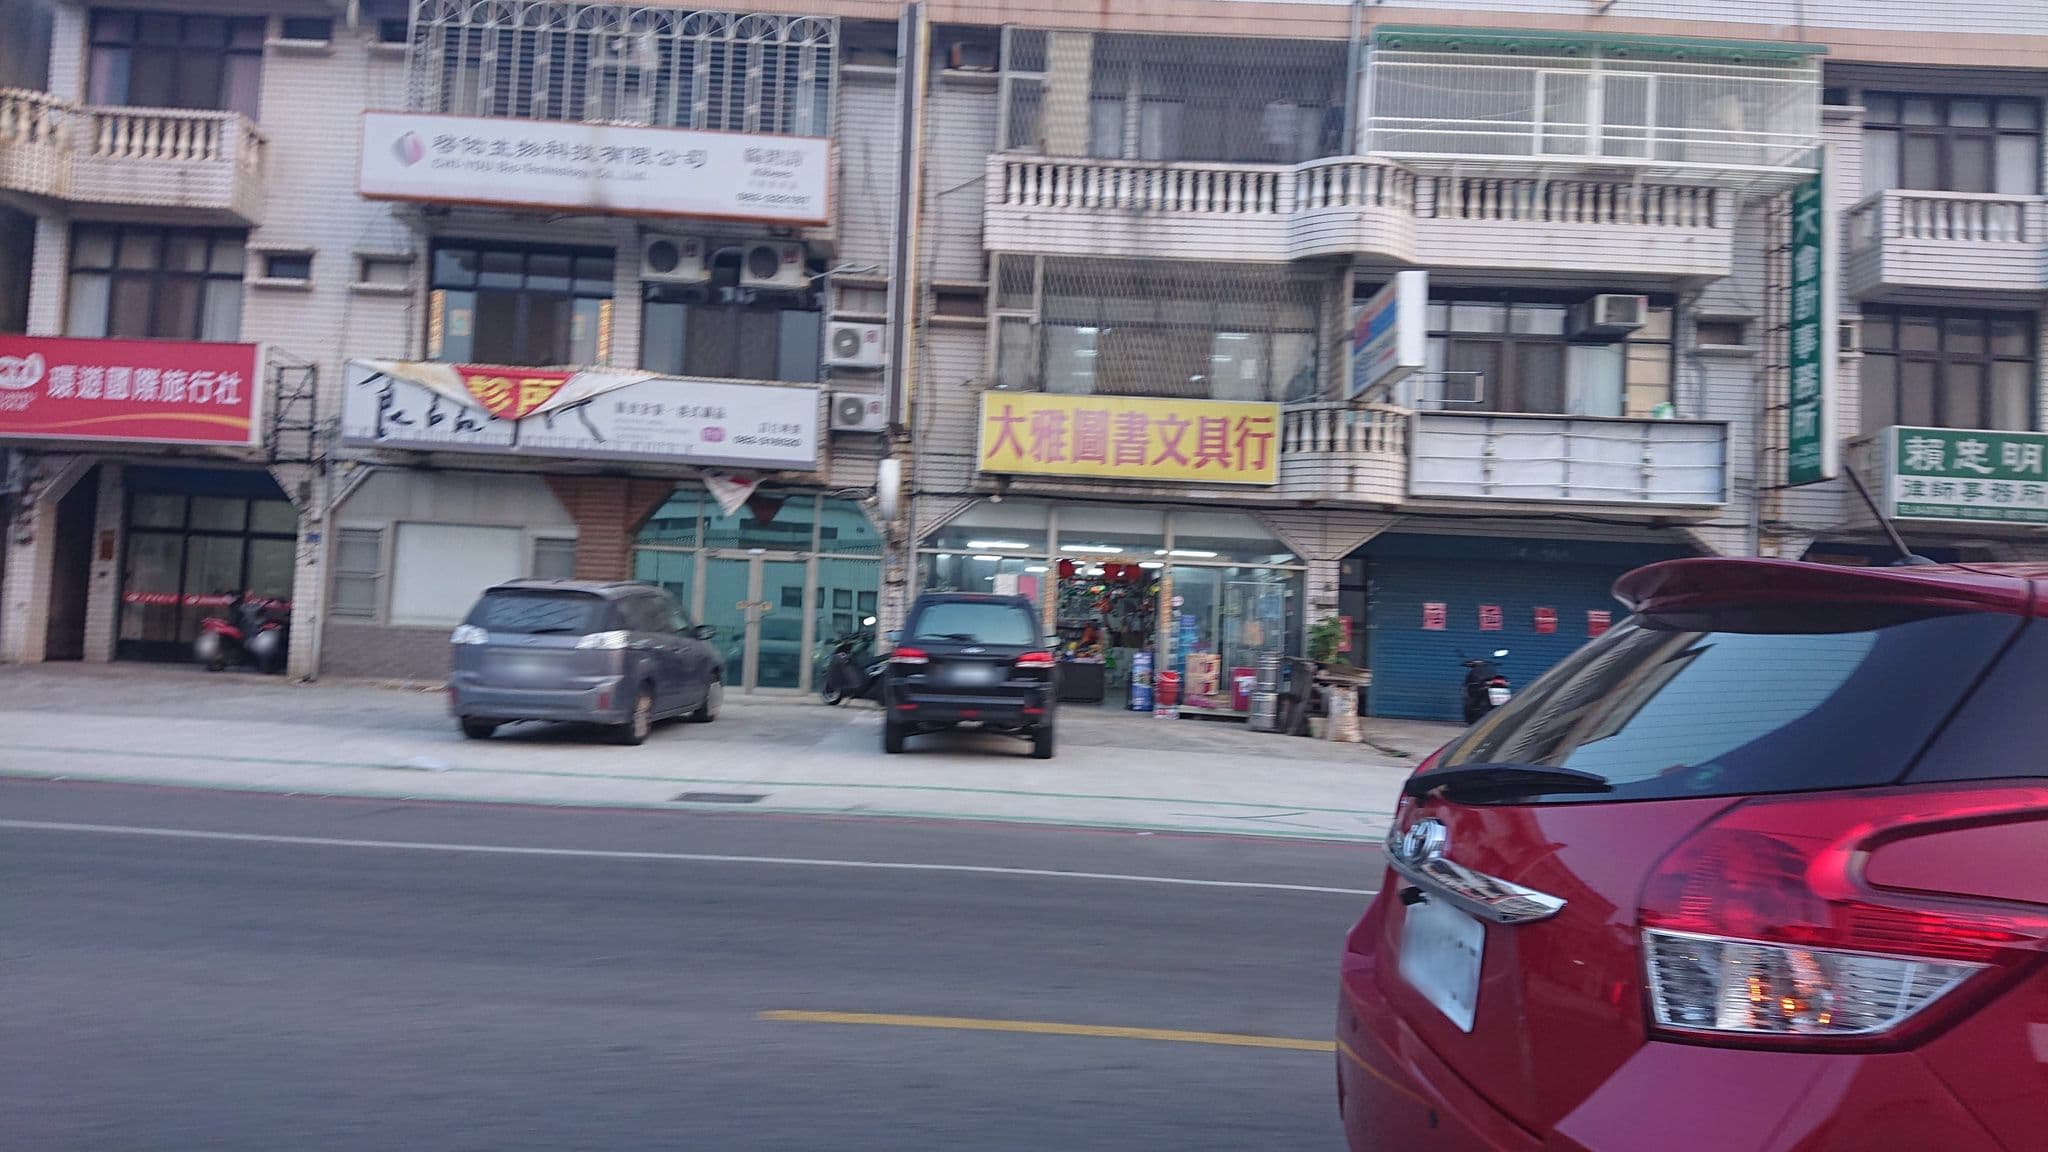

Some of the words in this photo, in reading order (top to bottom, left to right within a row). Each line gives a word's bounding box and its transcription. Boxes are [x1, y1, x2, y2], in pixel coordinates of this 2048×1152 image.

[47, 365, 242, 405] 環遊國際旅行社
[986, 404, 1275, 471] 大雅圖書文具行
[1904, 436, 2045, 474] 賴忠明
[1901, 479, 2047, 504] 律師事務所
